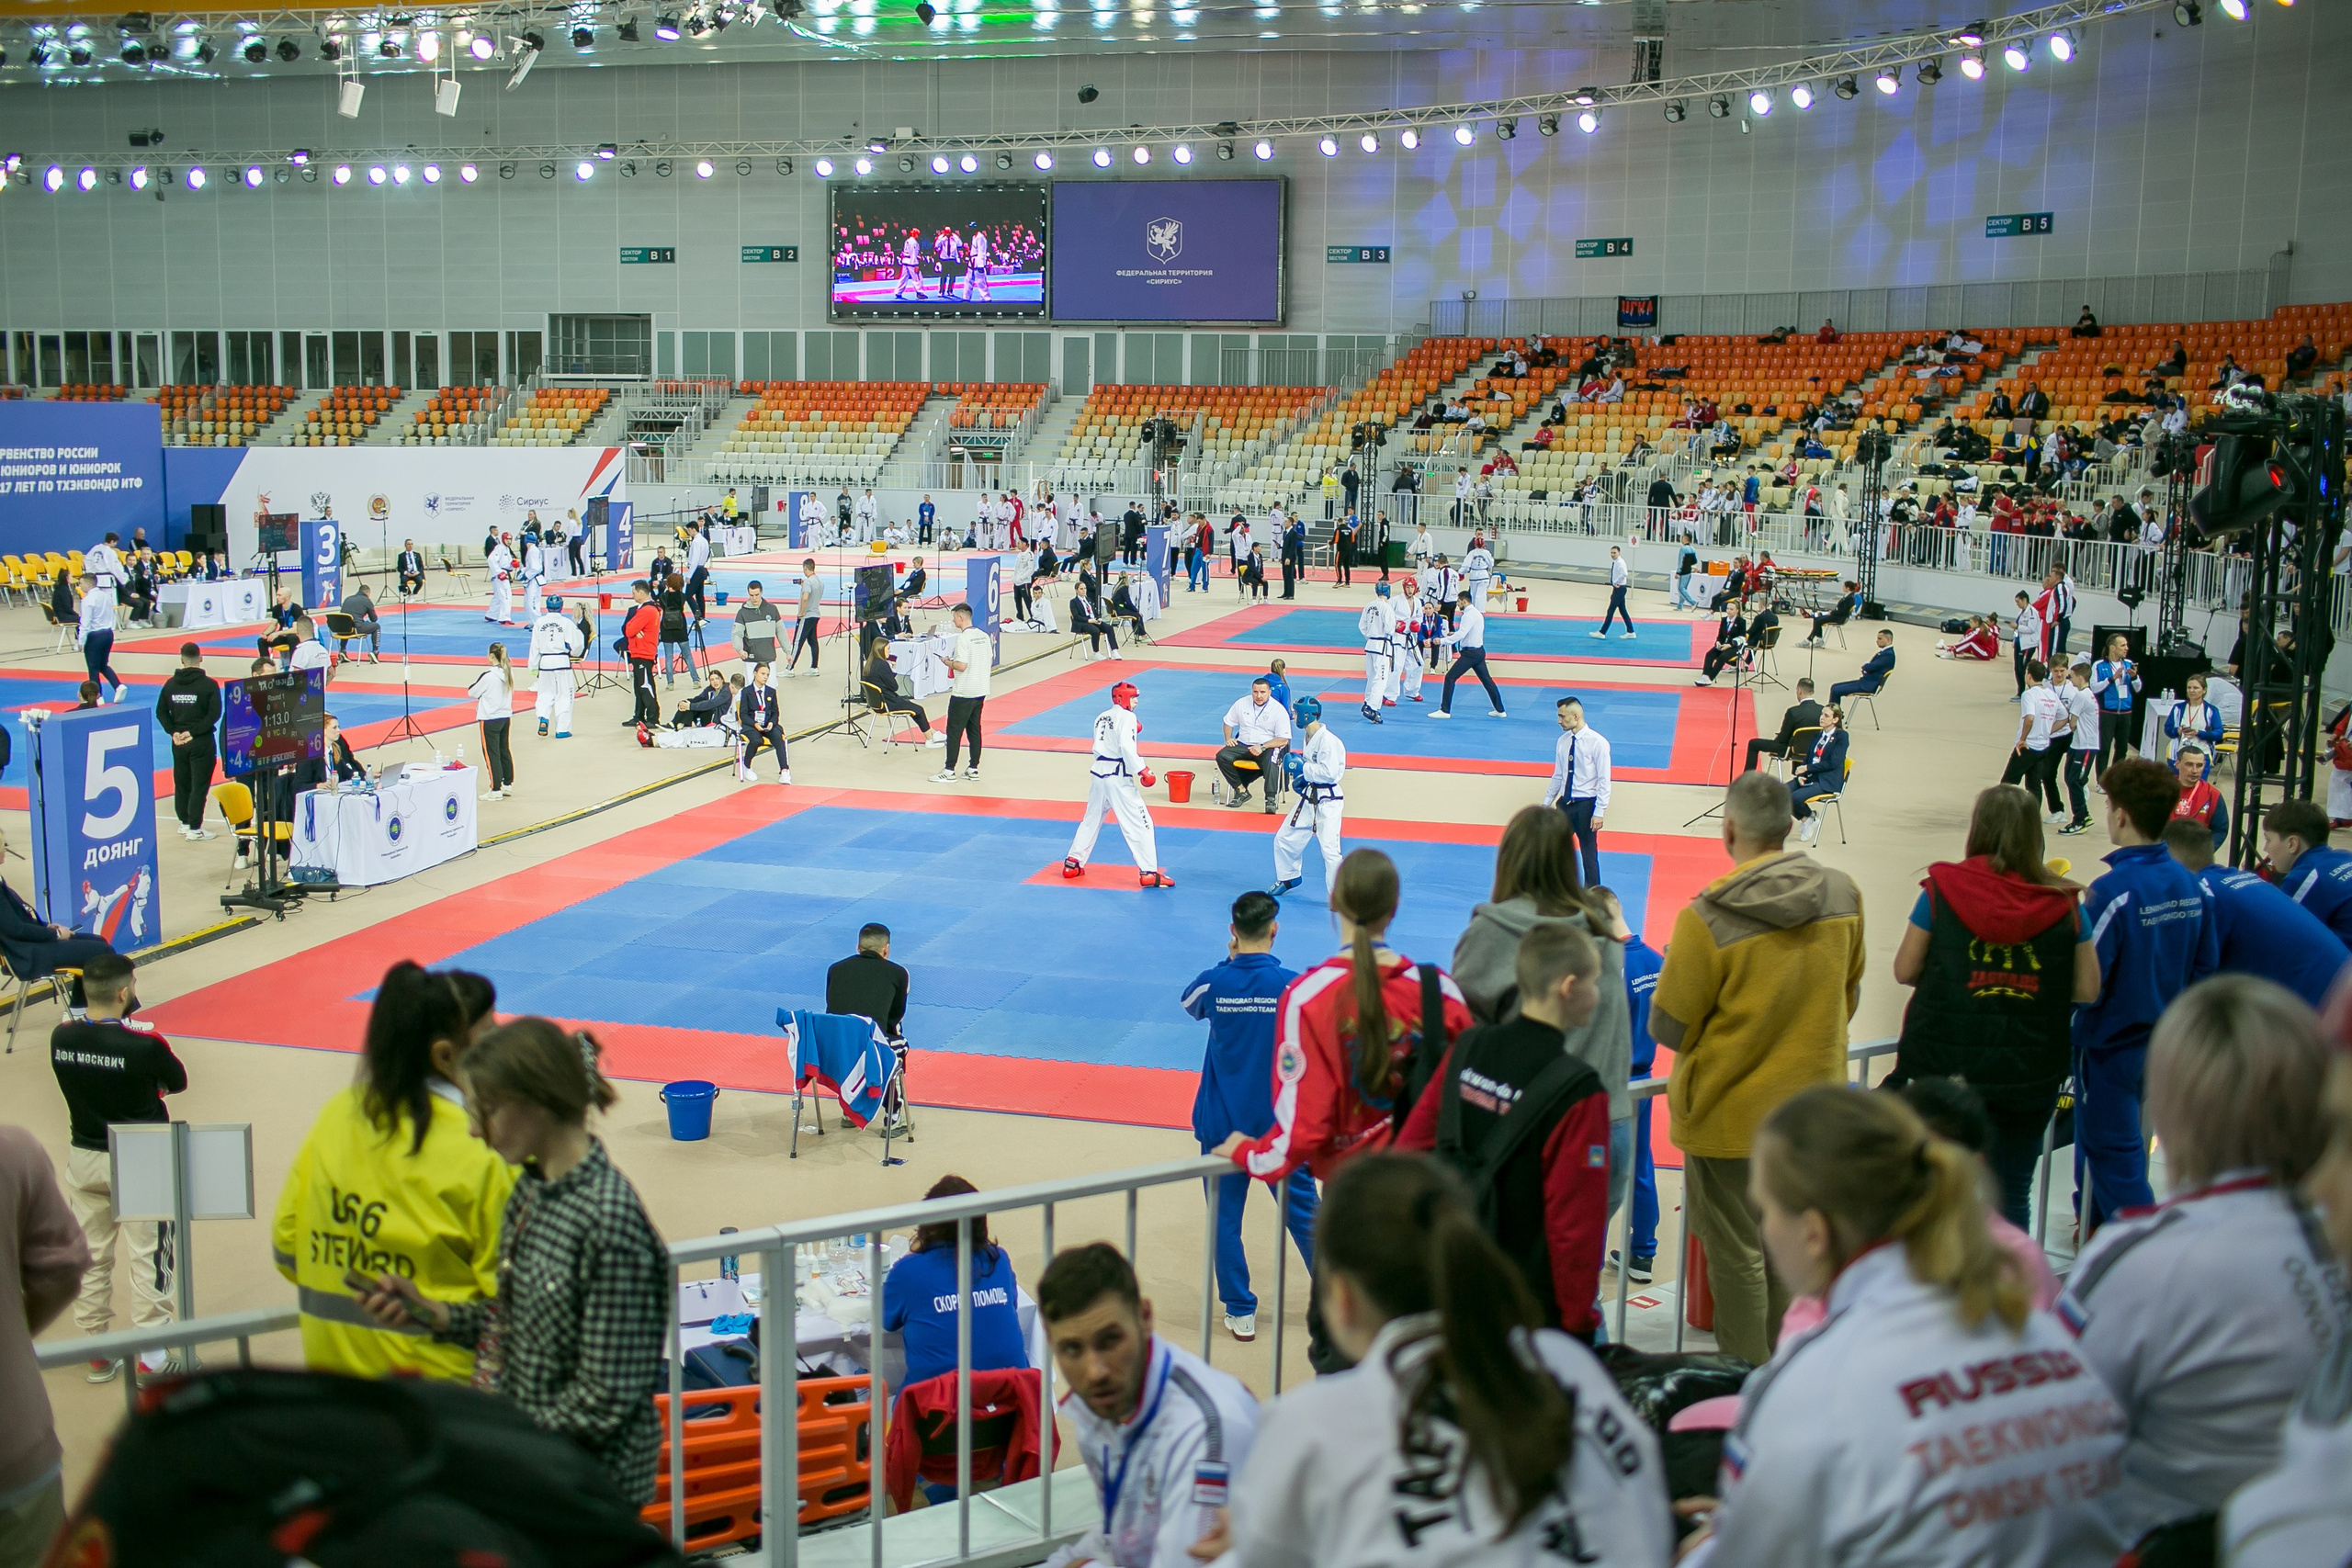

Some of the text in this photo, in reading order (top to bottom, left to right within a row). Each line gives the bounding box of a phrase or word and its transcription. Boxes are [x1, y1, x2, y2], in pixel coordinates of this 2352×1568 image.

[2040, 218, 2047, 229] 5
[665, 251, 670, 260] 1
[787, 250, 794, 258] 2
[1378, 250, 1385, 259] 3
[1622, 242, 1628, 253] 4
[57, 446, 98, 458] РОССИИ
[1, 462, 121, 477] ЮНИОРОВ И ЮНИОРОК
[14, 481, 37, 492] ЛЕТ
[38, 480, 54, 492] ПО
[56, 478, 119, 491] ТХЭКВОНДО
[121, 477, 143, 489] ИТФ
[517, 497, 548, 507] Сириус
[799, 494, 808, 521] 8
[619, 505, 631, 536] 4
[318, 525, 336, 565] 3
[1162, 531, 1170, 569] 7
[988, 561, 1000, 613] 6
[310, 672, 322, 690] +4
[229, 686, 242, 705] +9
[244, 694, 252, 702] +2
[300, 694, 307, 702] +2
[265, 712, 289, 727] 1:13.0
[310, 734, 322, 751] +6
[230, 750, 243, 768] +4
[82, 724, 140, 840] 5
[84, 838, 143, 870] ДОЯНГ
[55, 1049, 125, 1068] ДФК МОСКВИЧ
[311, 1230, 416, 1280] STEWRD
[933, 1287, 1008, 1313] СКОР ПОМОЩЬ
